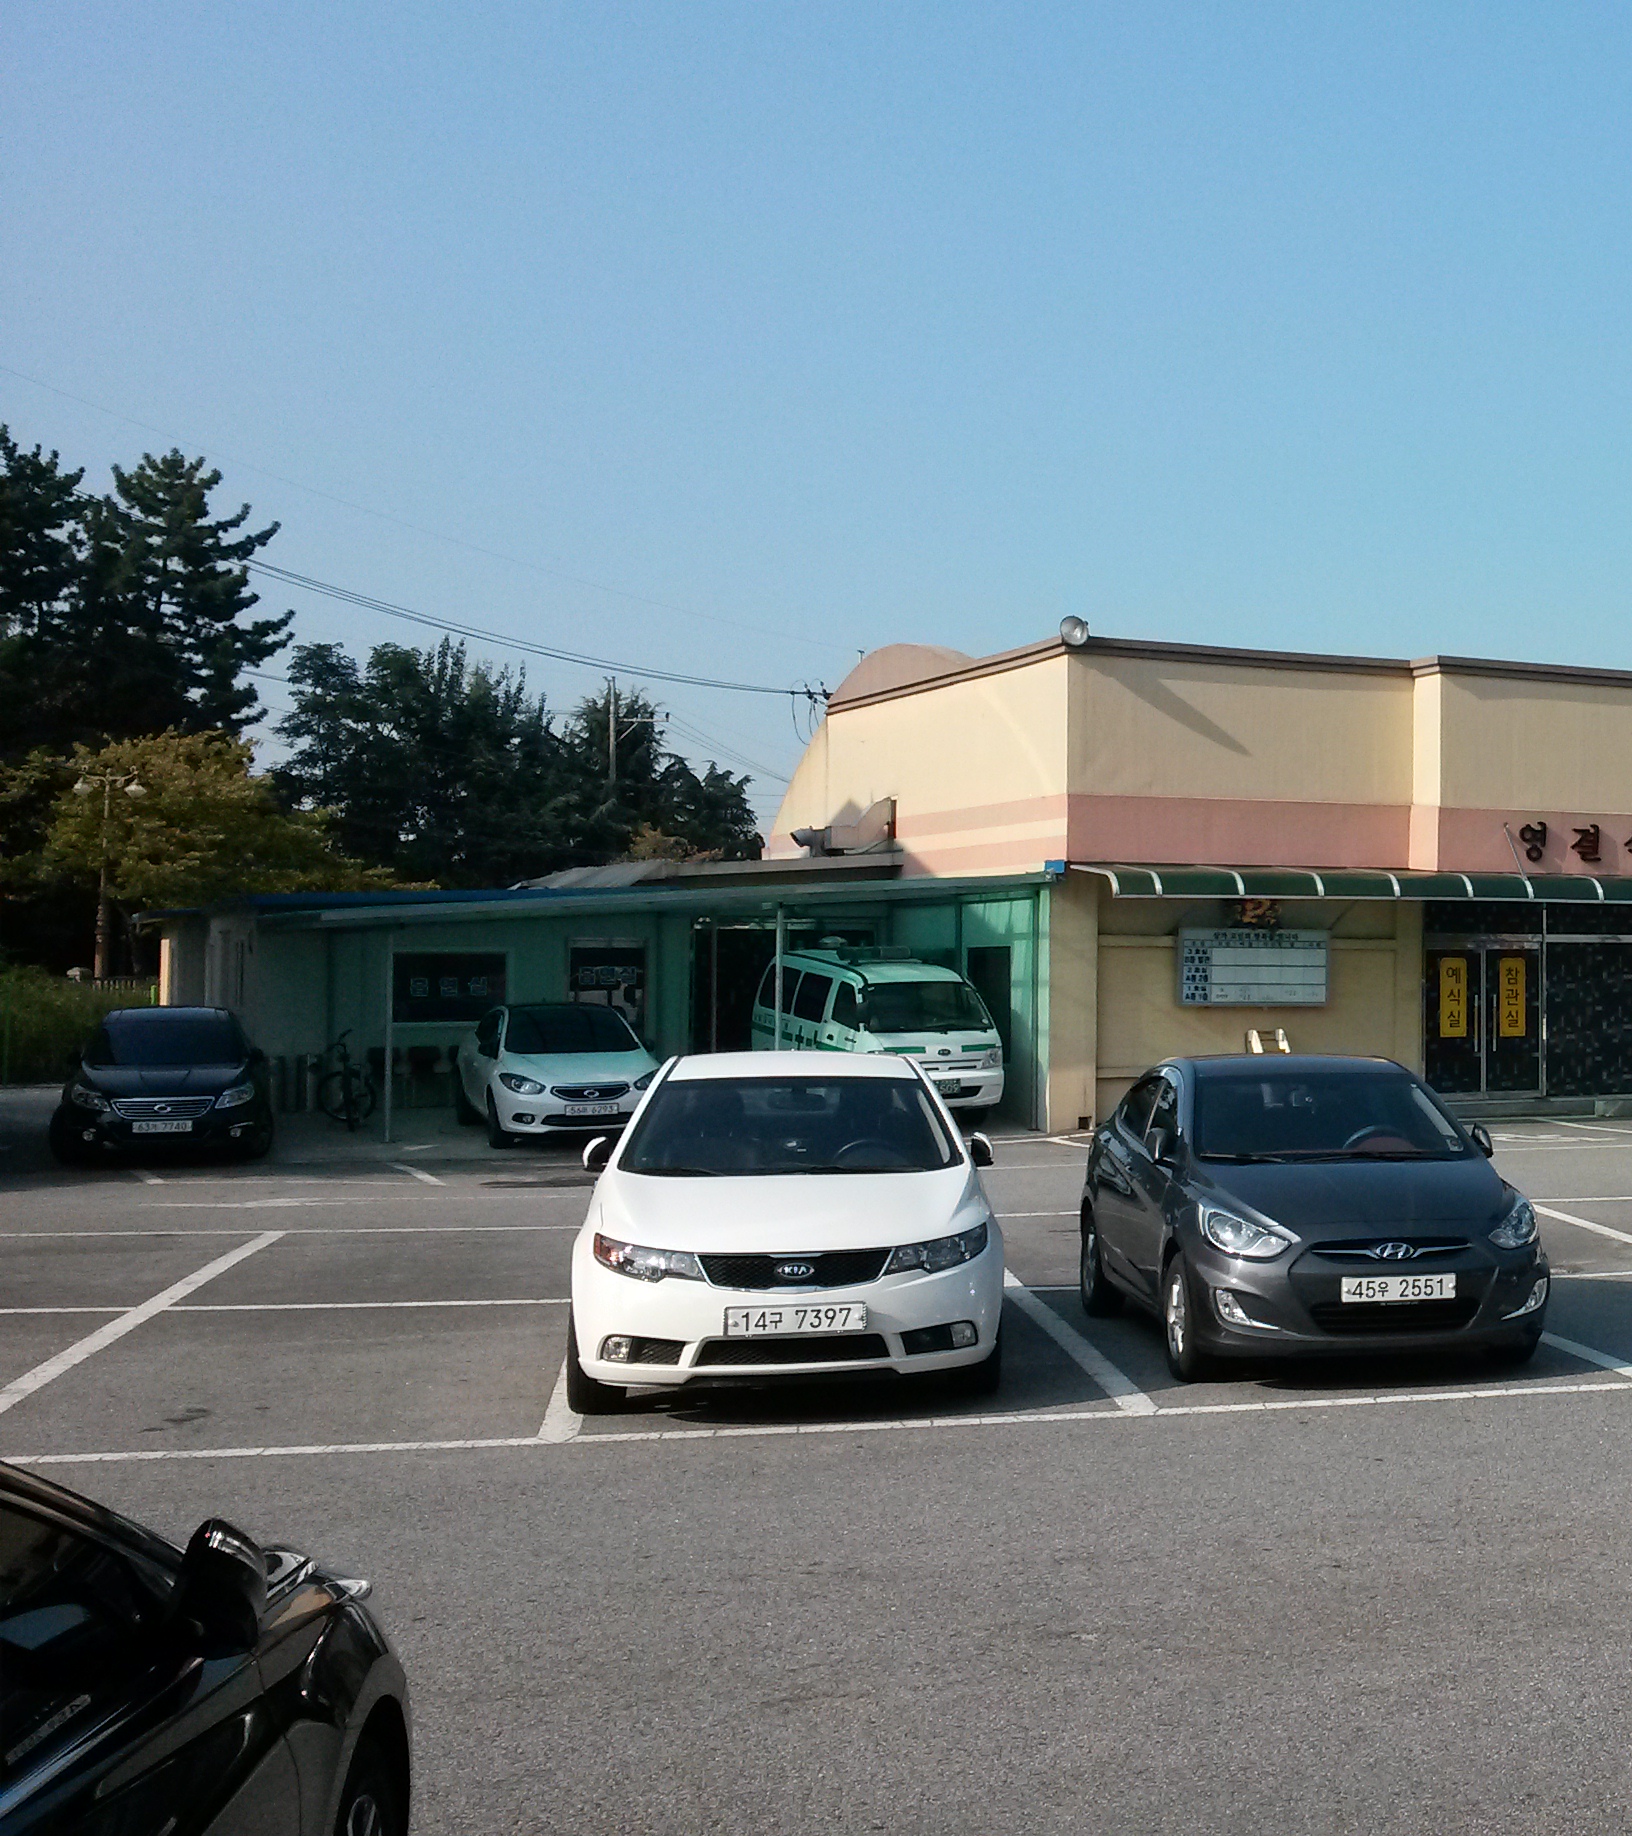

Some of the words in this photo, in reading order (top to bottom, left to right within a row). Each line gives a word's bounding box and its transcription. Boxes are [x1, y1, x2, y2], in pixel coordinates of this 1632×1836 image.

[1446, 966, 1461, 1028] 예식실
[1505, 966, 1520, 1028] 참관실
[161, 1121, 187, 1131] 7740
[783, 1266, 807, 1275] KIA
[1352, 1281, 1389, 1299] 45우
[1399, 1278, 1444, 1298] 2551
[741, 1311, 783, 1332] 14구
[795, 1307, 852, 1329] 7397
